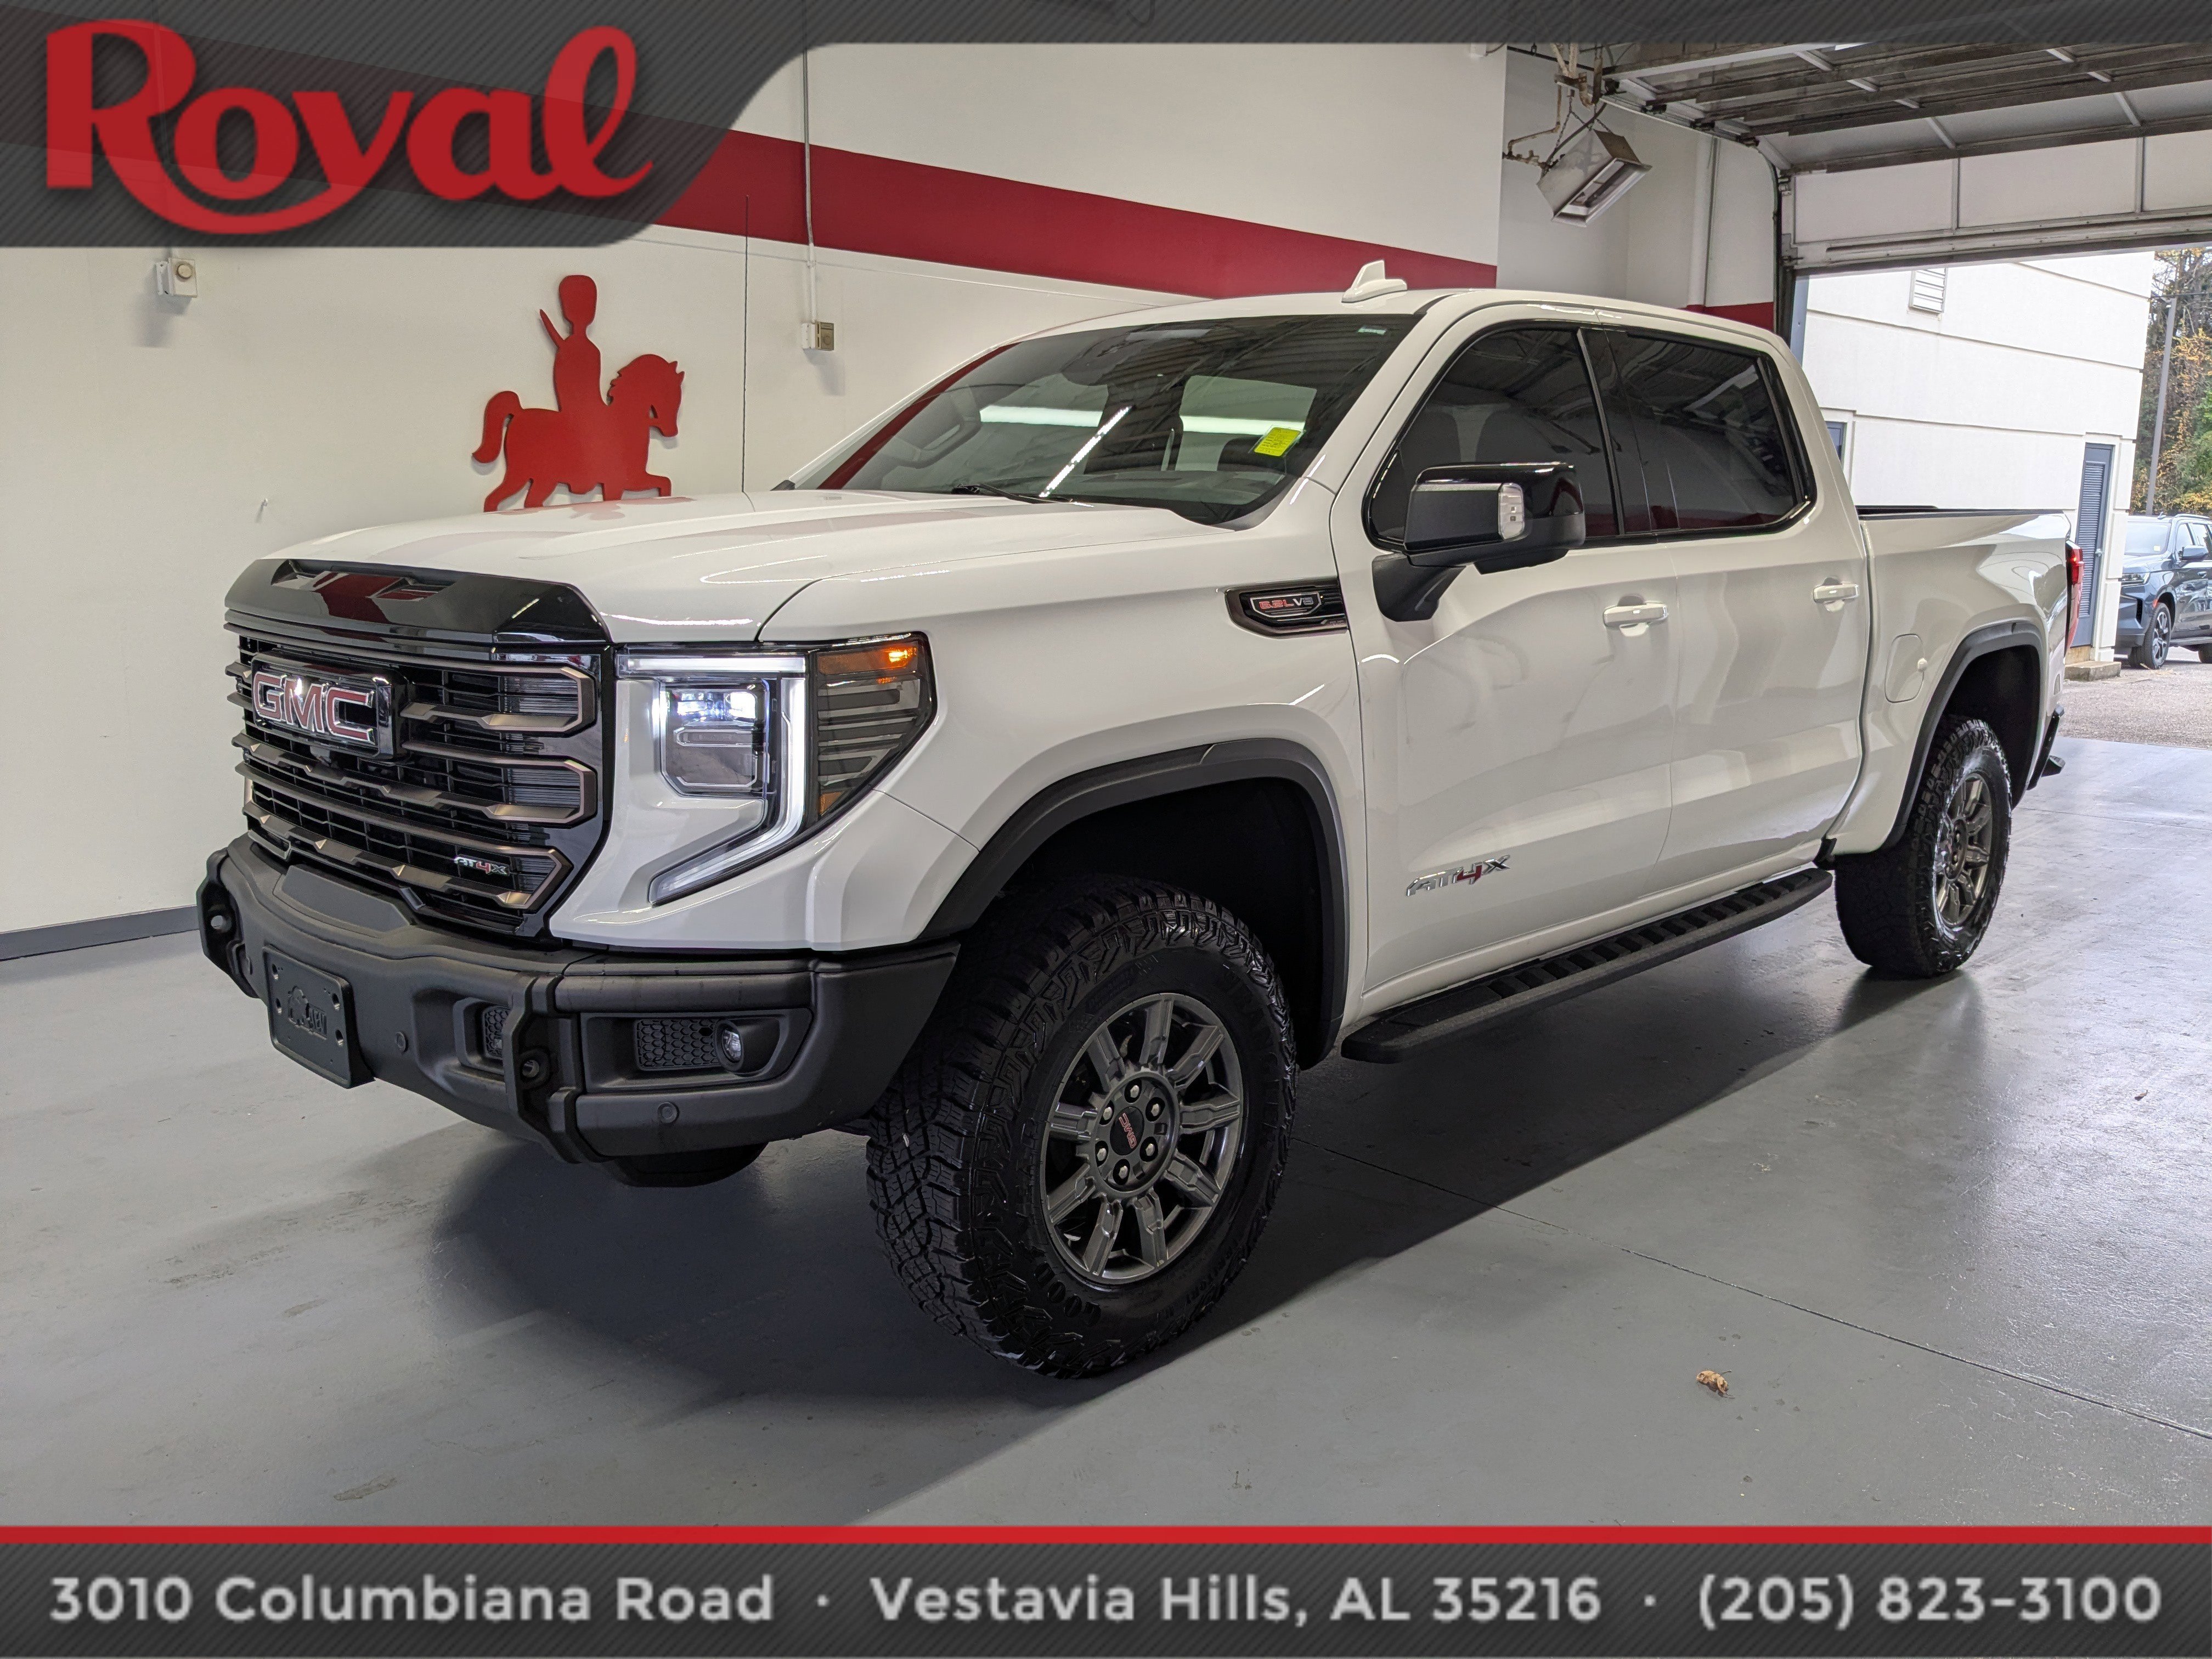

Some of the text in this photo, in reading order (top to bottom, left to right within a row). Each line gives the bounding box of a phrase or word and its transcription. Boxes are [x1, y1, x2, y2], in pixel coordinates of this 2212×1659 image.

[253, 671, 375, 745] GMC
[454, 856, 509, 875] AT4X
[1406, 854, 1511, 897] AT4X
[1119, 1113, 1137, 1149] GMC
